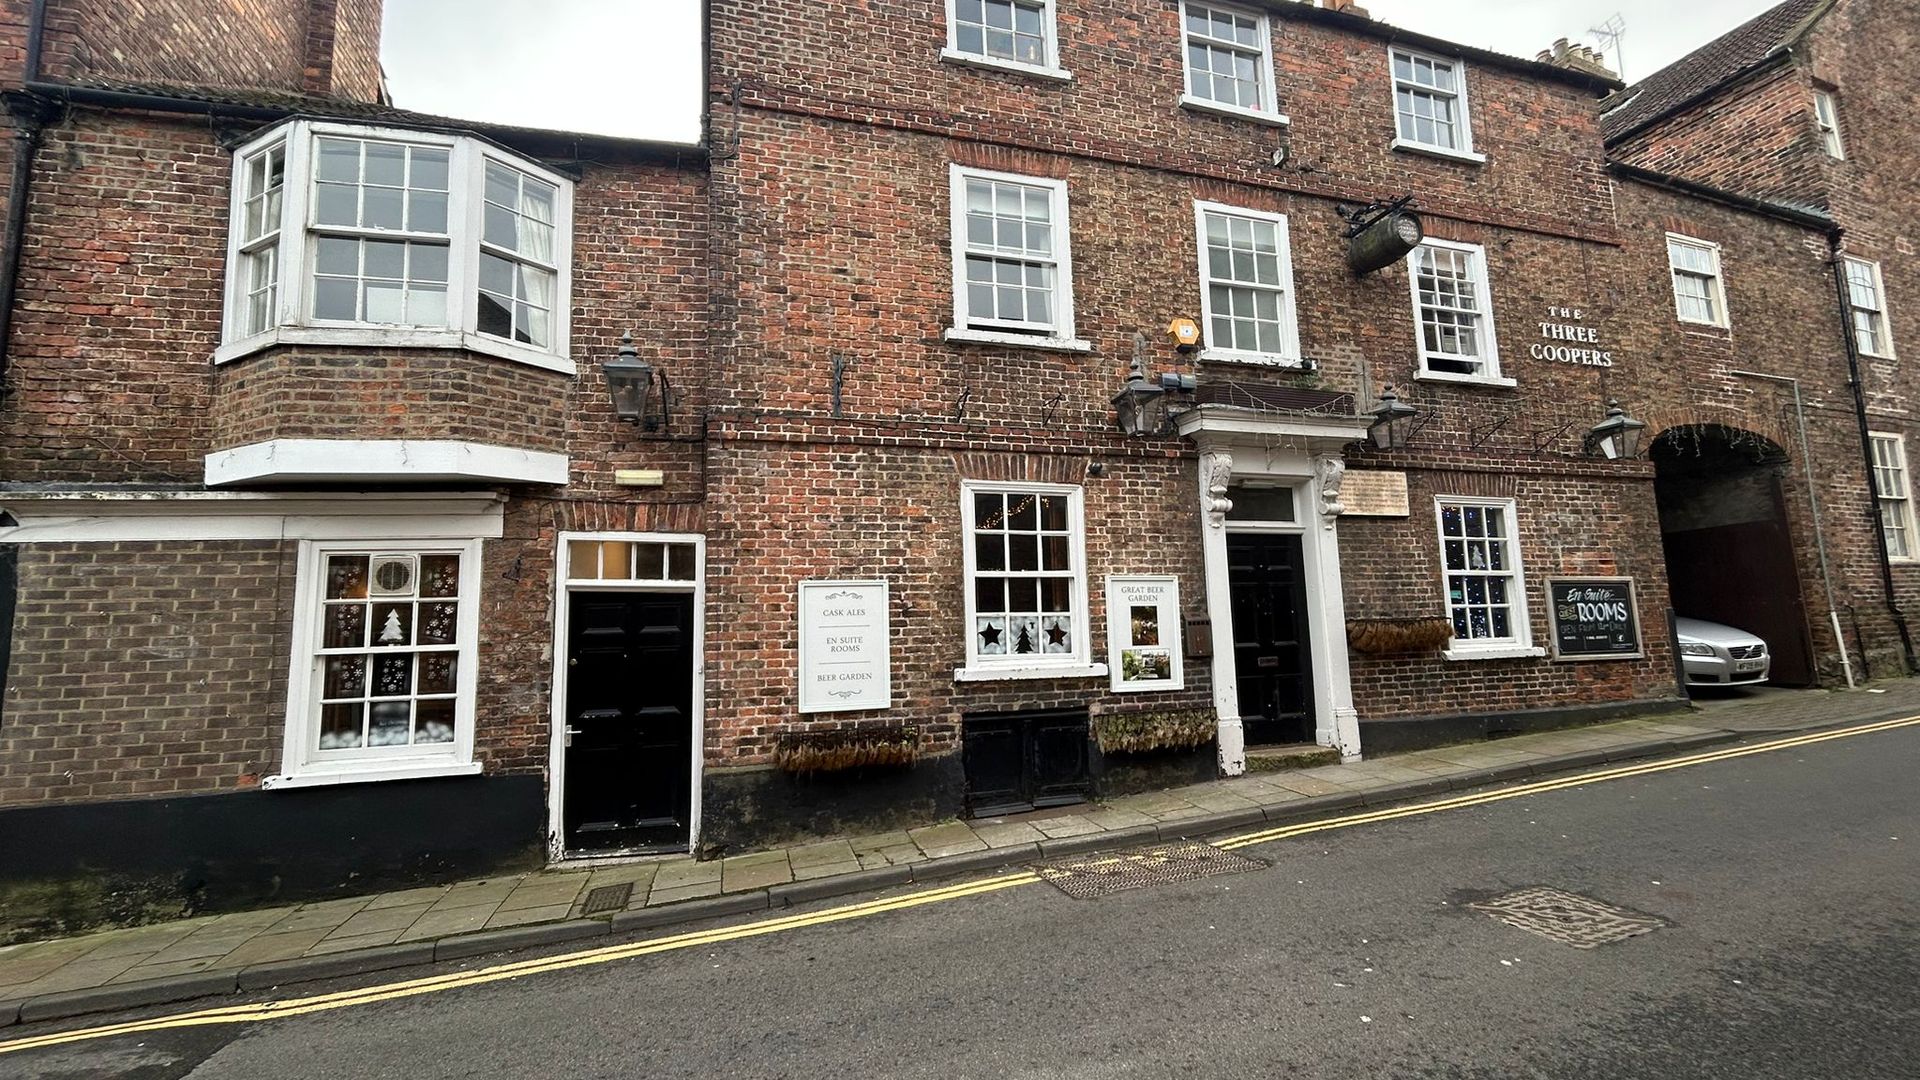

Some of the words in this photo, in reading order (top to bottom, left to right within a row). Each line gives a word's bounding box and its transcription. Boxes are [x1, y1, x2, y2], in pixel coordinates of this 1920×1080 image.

[1548, 306, 1582, 320] THE
[1538, 322, 1598, 343] THREE
[1531, 343, 1612, 367] COOPERS
[1128, 594, 1158, 602] GARDEN
[1567, 588, 1582, 602] En
[1584, 588, 1612, 601] Suite
[823, 609, 844, 617] CASK
[847, 608, 866, 616] ALES
[1577, 602, 1627, 622] ROOMS
[826, 637, 837, 645] EN
[840, 636, 863, 644] SUITE
[831, 645, 860, 653] ROOMS
[817, 673, 837, 682] BEER
[840, 672, 872, 681] GARDEN
